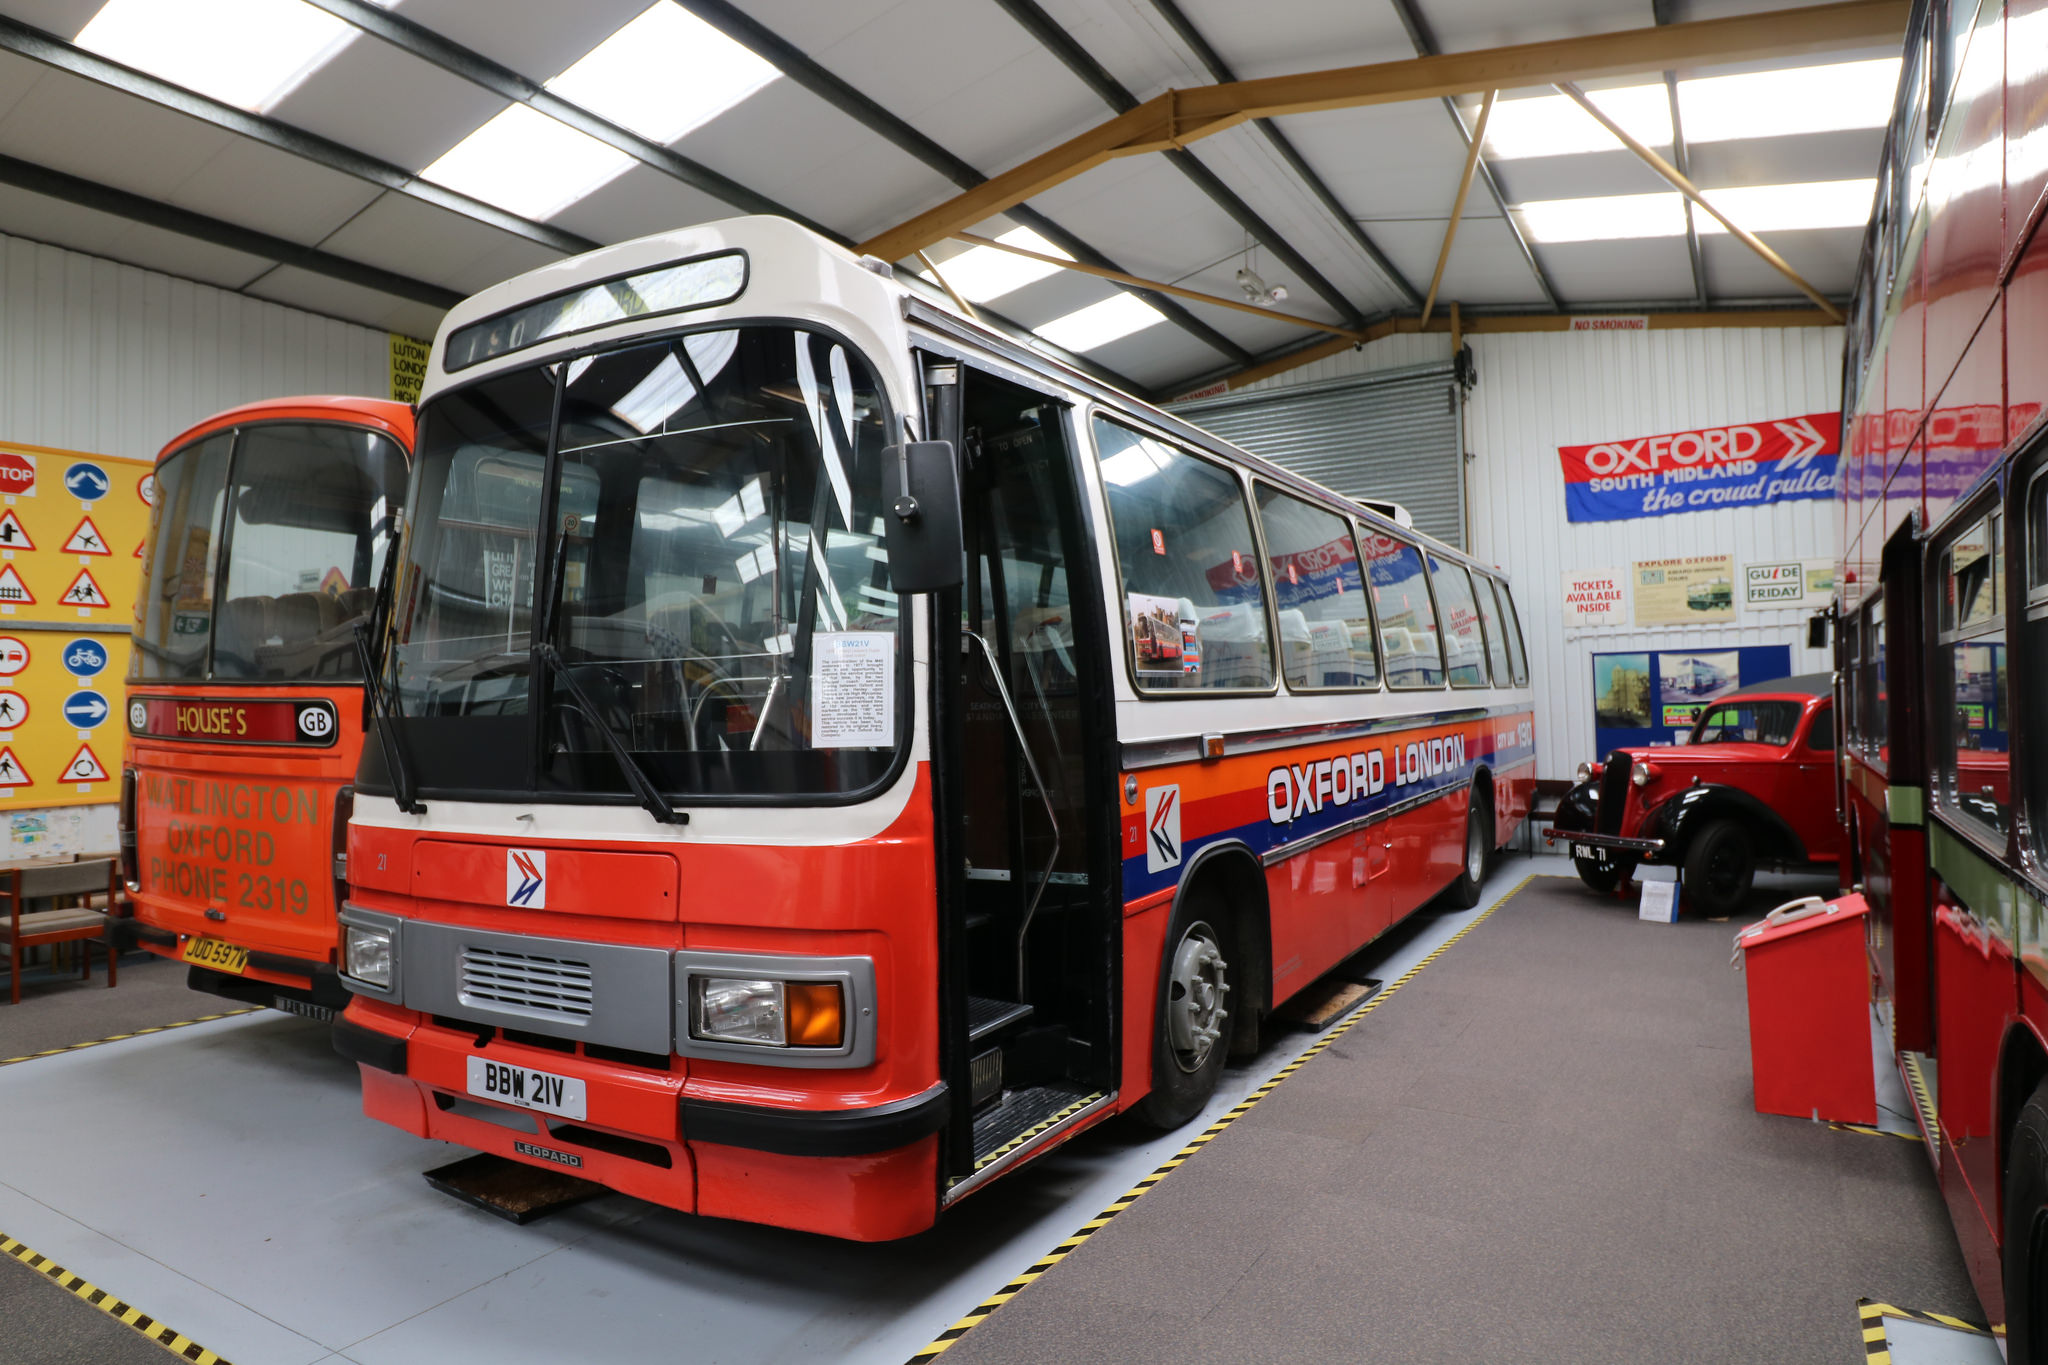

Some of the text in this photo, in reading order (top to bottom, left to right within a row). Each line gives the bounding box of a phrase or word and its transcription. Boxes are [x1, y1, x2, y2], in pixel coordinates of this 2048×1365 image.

[1575, 319, 1644, 330] NO SMOKING
[393, 342, 425, 361] LUTON
[393, 358, 428, 376] LONDO
[394, 374, 424, 391] OXFO
[394, 389, 417, 403] HIGH
[1189, 384, 1227, 400] SMOKING
[1585, 426, 1762, 475] OXFORD
[0, 467, 33, 481] TOP
[1590, 459, 1757, 493] SOUTH MIDLAND
[1642, 487, 1684, 512] the
[1688, 475, 1767, 506] crowd
[491, 563, 513, 577] GRE
[1638, 555, 1726, 568] EXPLORE OXFORD
[1572, 579, 1614, 591] TICKETS
[1751, 587, 1798, 598] FRIDAY
[1566, 590, 1622, 603] AVAILABLE
[1577, 602, 1611, 613] INSIDE
[132, 709, 144, 724] GB
[176, 706, 247, 735] HOUSE'S
[304, 712, 327, 732] GB
[1517, 721, 1532, 748] 190
[1267, 734, 1466, 825] OXFORD LONDON
[145, 776, 319, 825] WATLINGTON
[168, 819, 276, 867] OXFORD
[1129, 826, 1138, 843] 21
[377, 853, 388, 871] 21
[1596, 847, 1607, 861] 71
[151, 856, 309, 915] PHONE 2319
[485, 1063, 564, 1107] BBW 21V
[517, 1141, 579, 1166] LEOPARD
